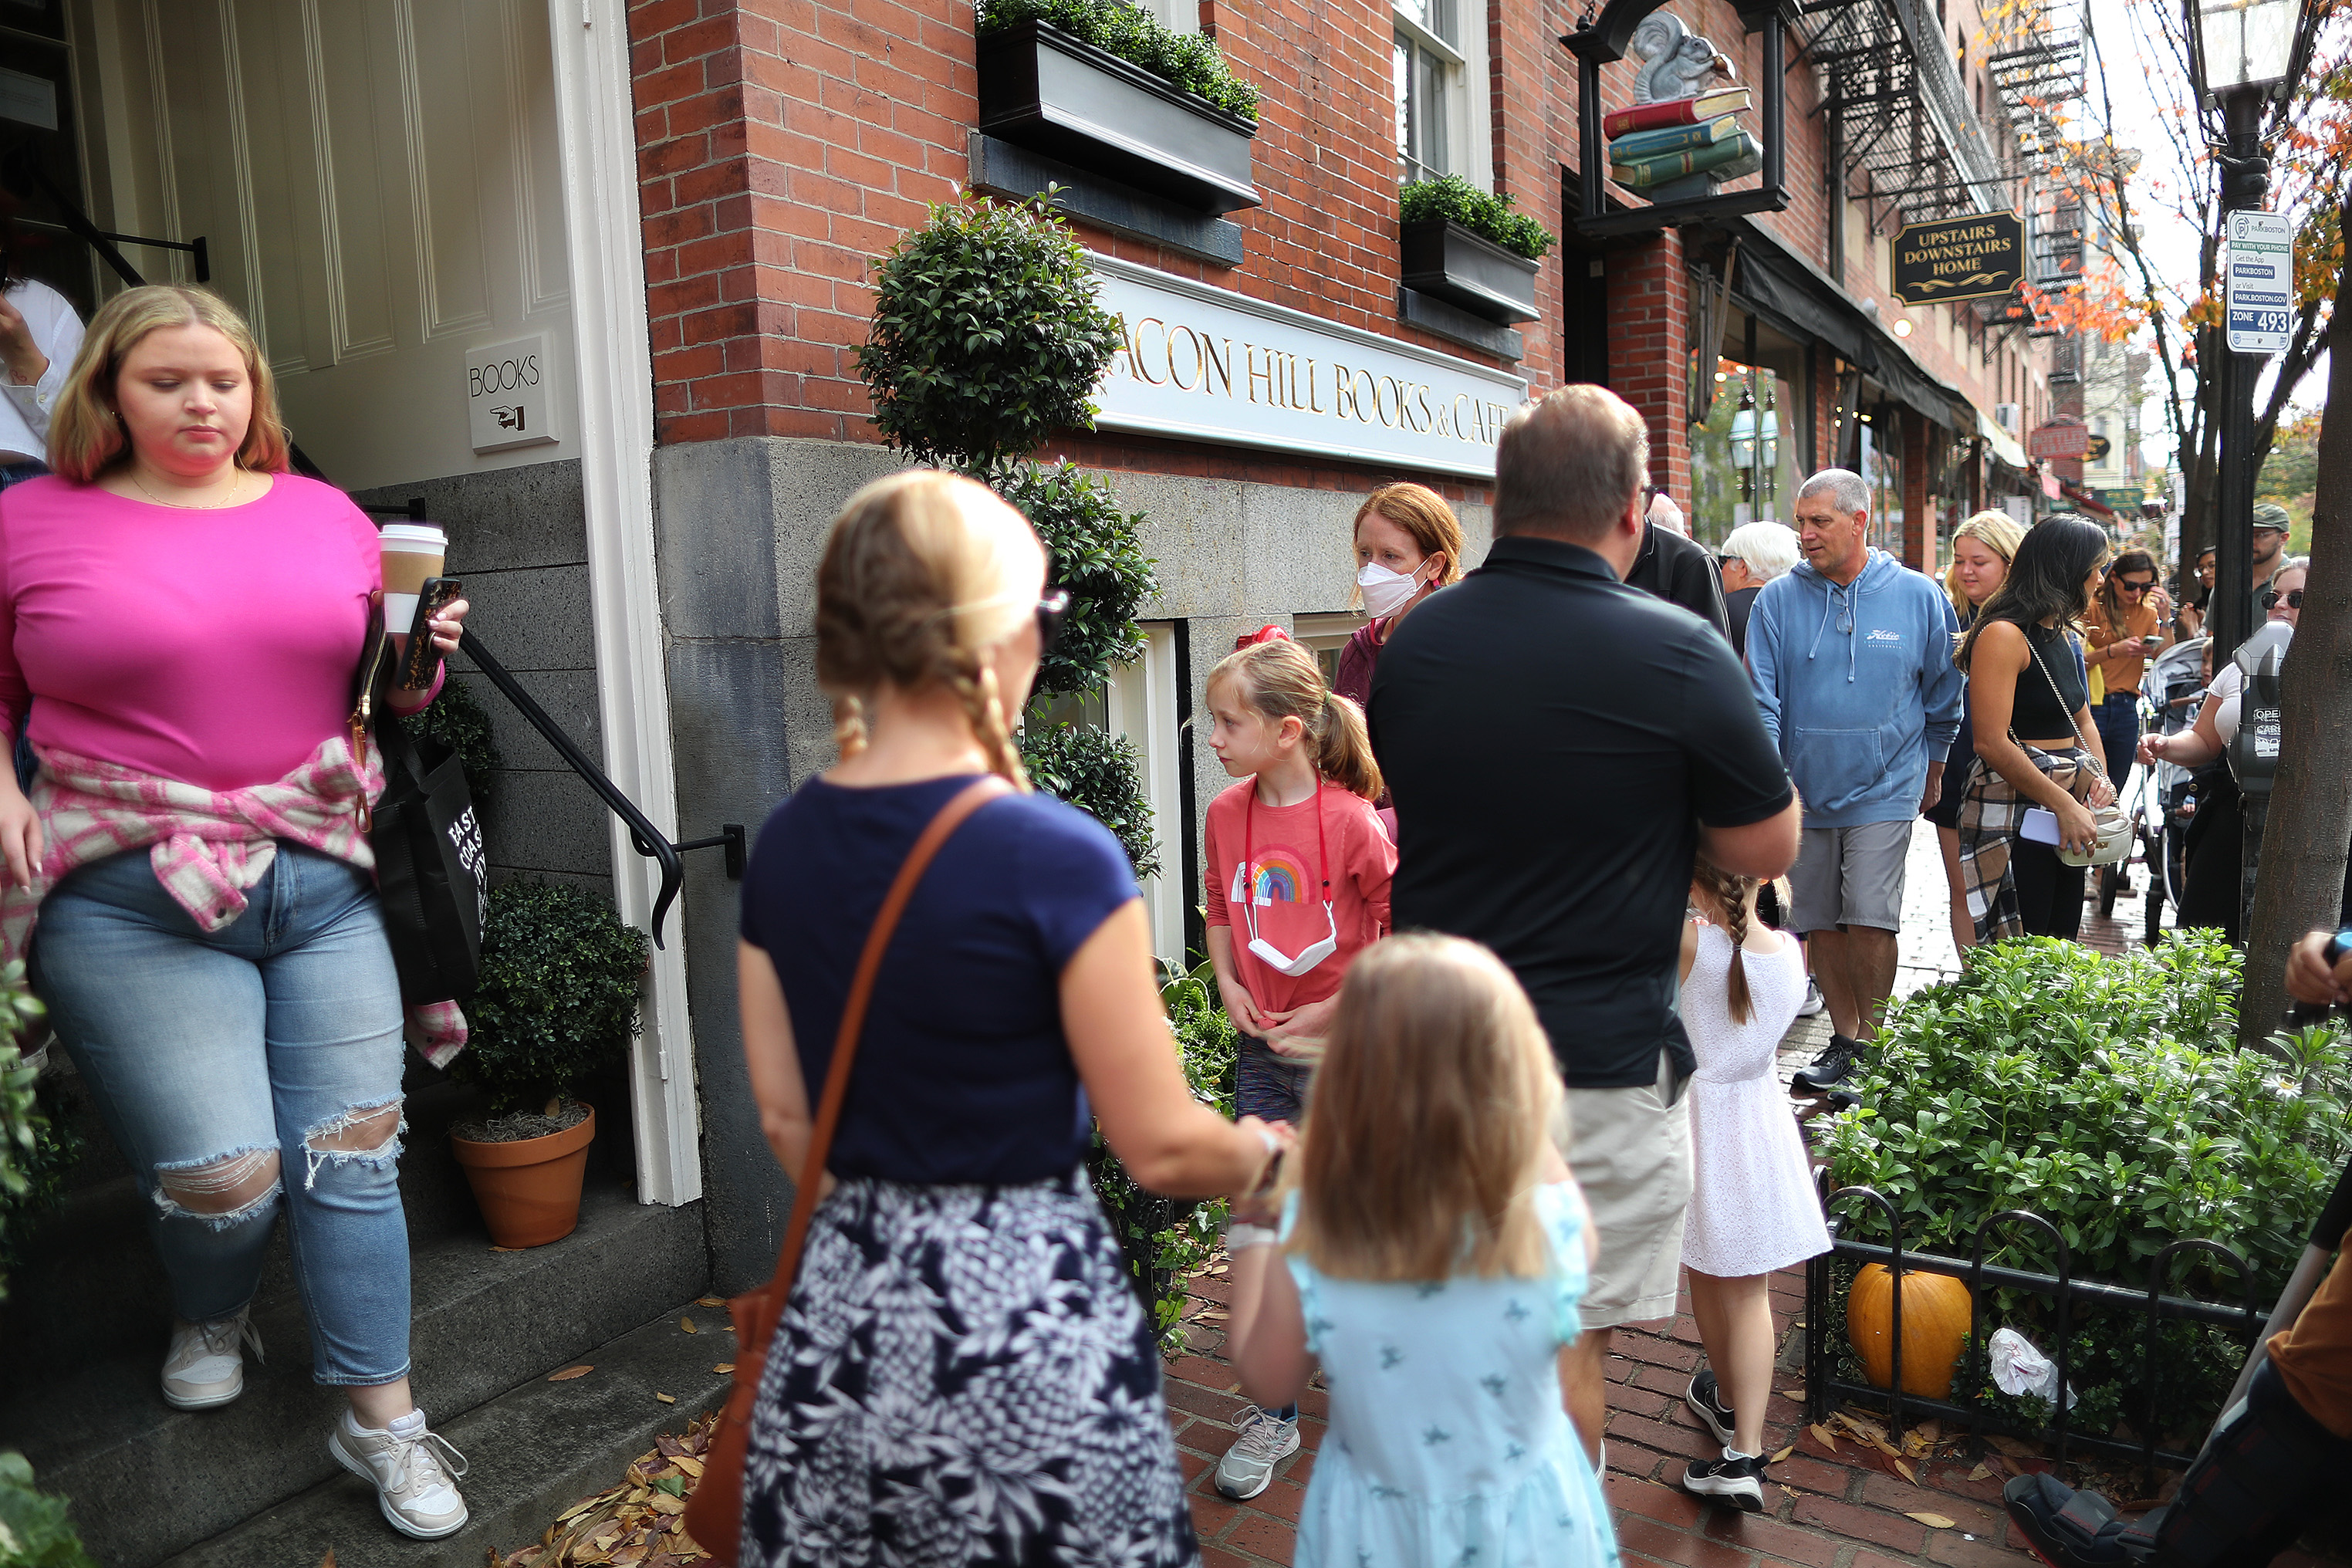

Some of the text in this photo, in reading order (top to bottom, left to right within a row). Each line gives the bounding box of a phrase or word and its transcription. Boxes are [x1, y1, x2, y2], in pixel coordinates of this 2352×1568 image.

[1918, 224, 1996, 248] UPSTAIRS
[2251, 225, 2286, 234] PARKBOSTON
[1904, 237, 2012, 265] DOWNSTAIRS
[1932, 257, 1982, 276] HOME
[2235, 267, 2273, 275] PARKBOSTON
[2235, 293, 2287, 303] PARK.BOSTON.GOV
[2232, 311, 2287, 332] ZONE 493
[469, 355, 539, 397] BOOKS
[1106, 312, 1233, 399] ACON
[1243, 343, 1327, 416] HILL
[1333, 363, 1433, 436] BOOKS
[1437, 404, 1452, 440] &
[448, 805, 476, 847] EAST
[474, 853, 487, 886] IVY
